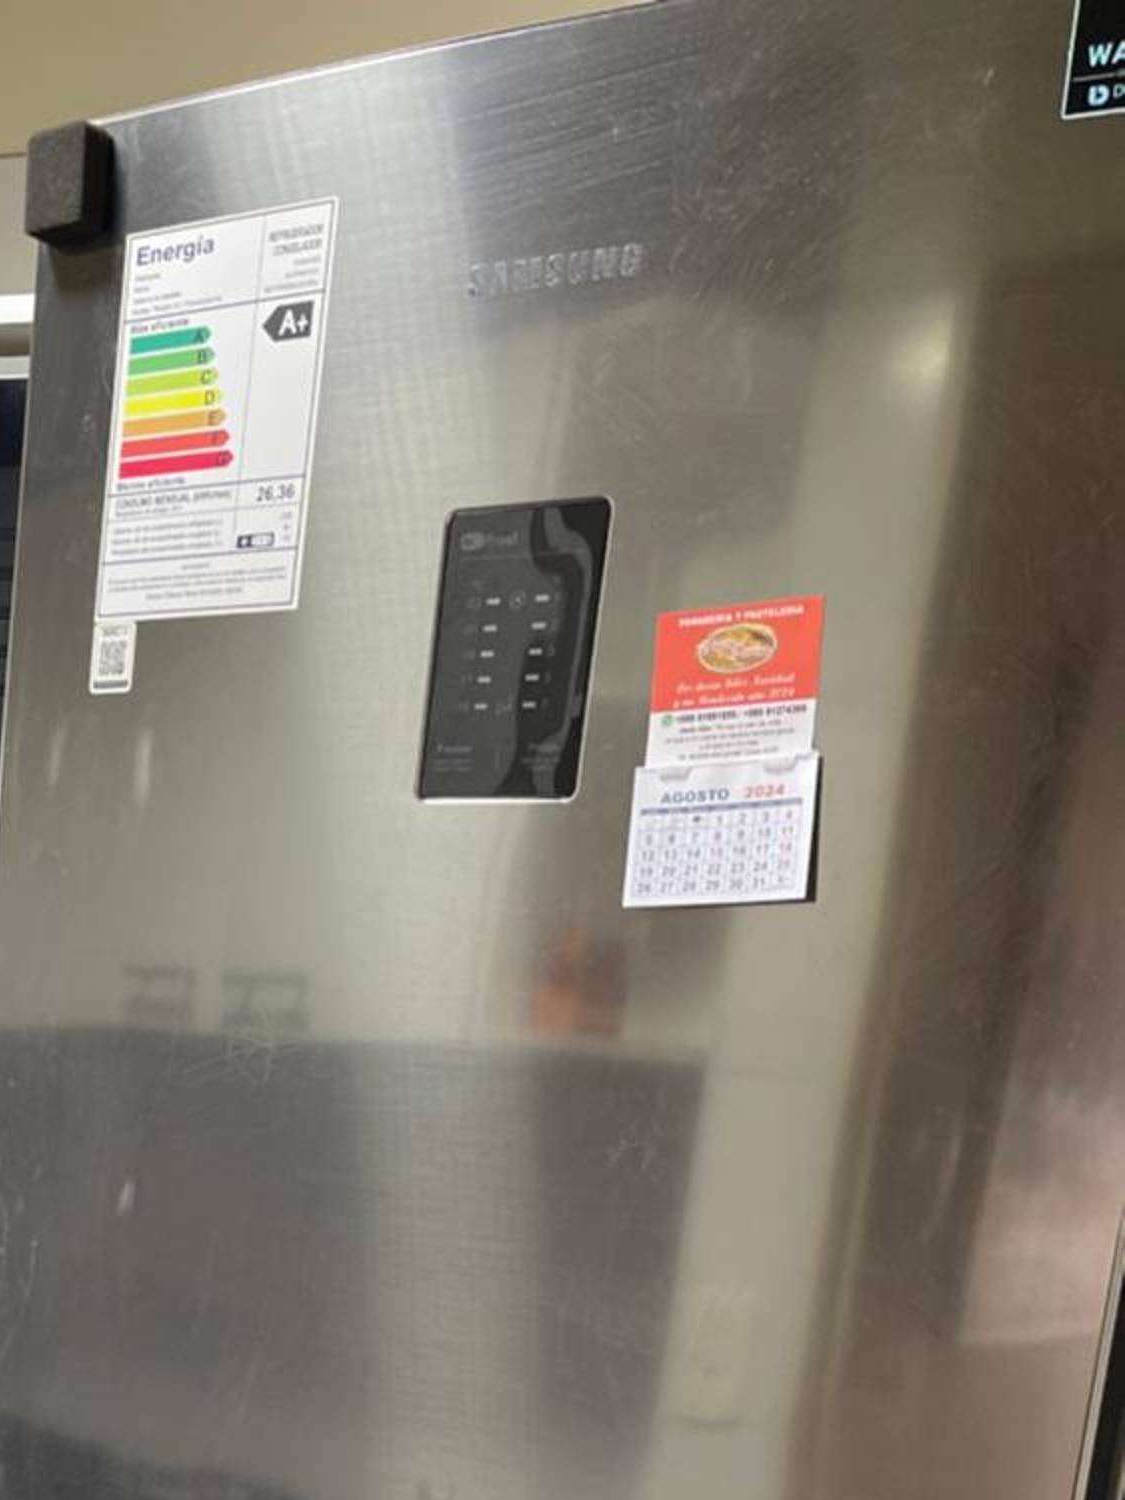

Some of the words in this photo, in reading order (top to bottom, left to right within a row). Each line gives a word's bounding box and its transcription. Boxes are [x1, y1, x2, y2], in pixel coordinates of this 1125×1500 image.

[136, 235, 215, 266] Energía
[467, 243, 644, 294] SAMSUNG
[278, 309, 310, 337] A+
[662, 789, 730, 803] AGOSTO
[745, 784, 786, 799] 2024
